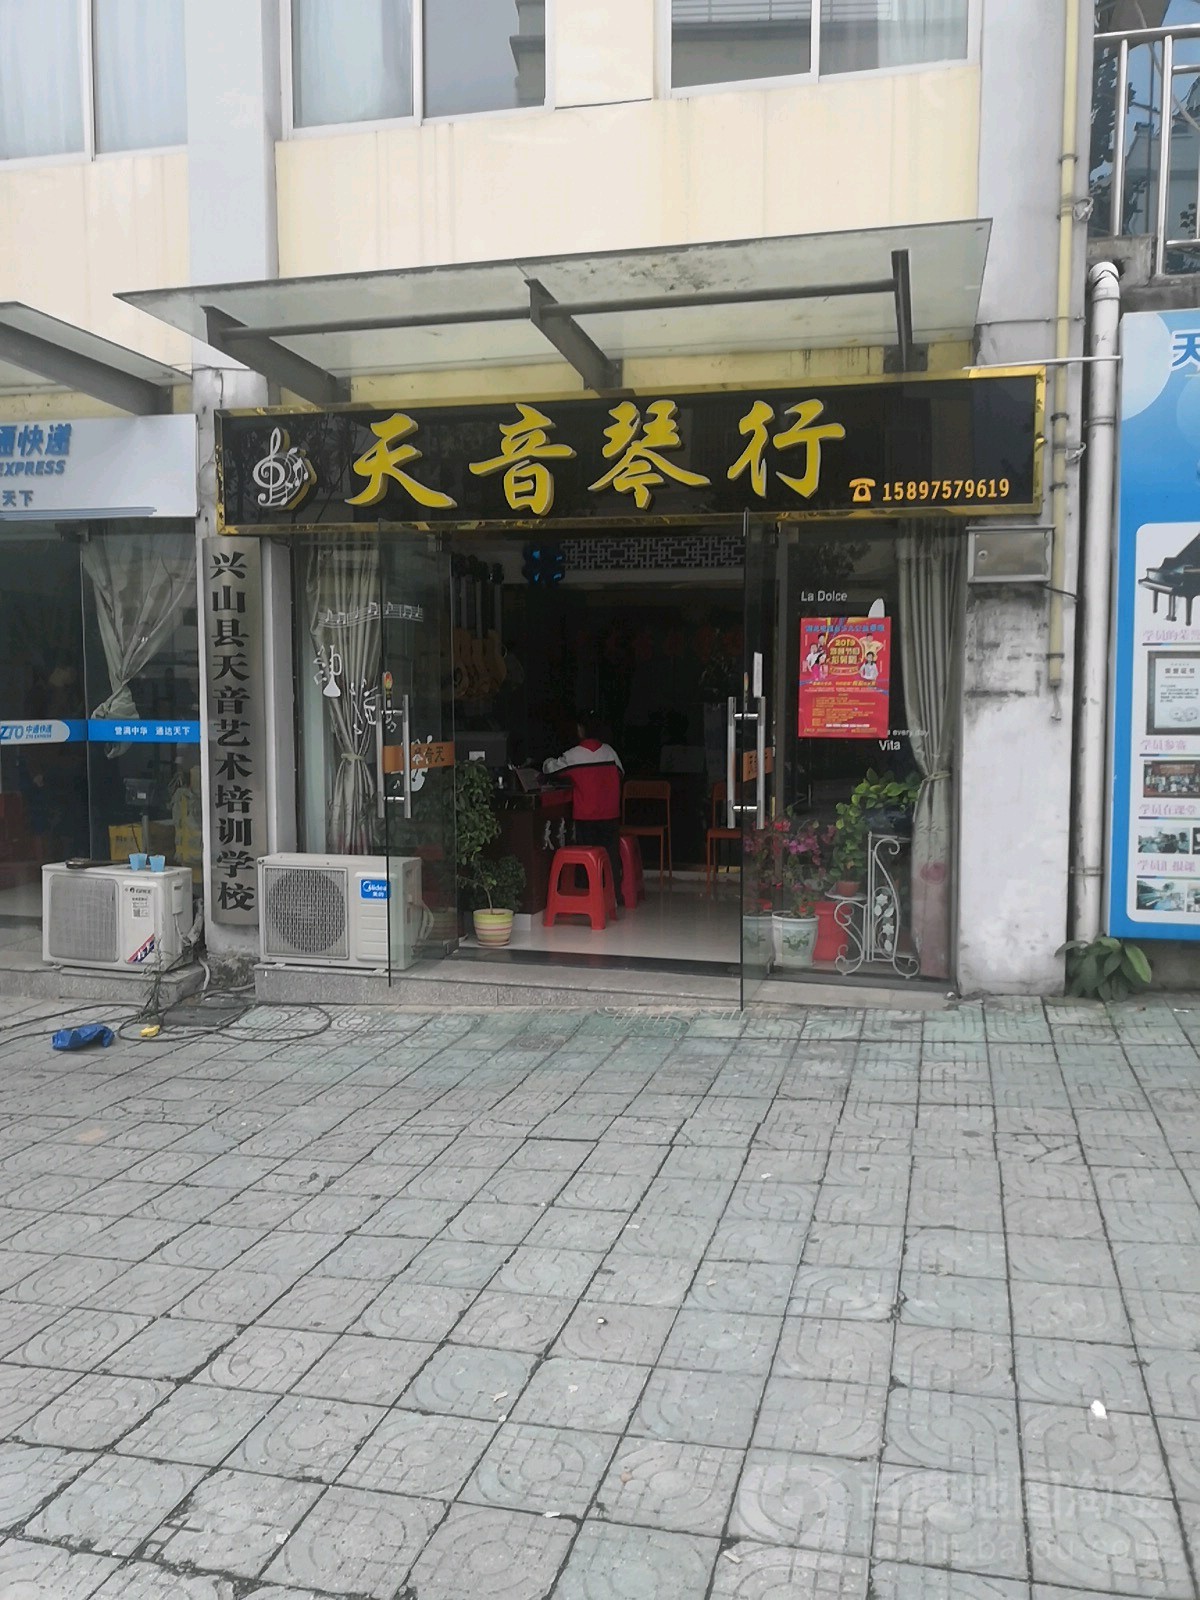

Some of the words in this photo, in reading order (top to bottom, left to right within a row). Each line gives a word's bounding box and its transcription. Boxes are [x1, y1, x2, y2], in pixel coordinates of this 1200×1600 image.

[343, 397, 848, 515] 天音琴行
[2, 489, 34, 507] 天下
[882, 478, 1010, 501] 15897579619
[801, 590, 815, 602] La
[817, 590, 848, 602] Dolce
[209, 551, 255, 911] 兴山县天音艺术培训学校
[879, 740, 901, 751] Vita
